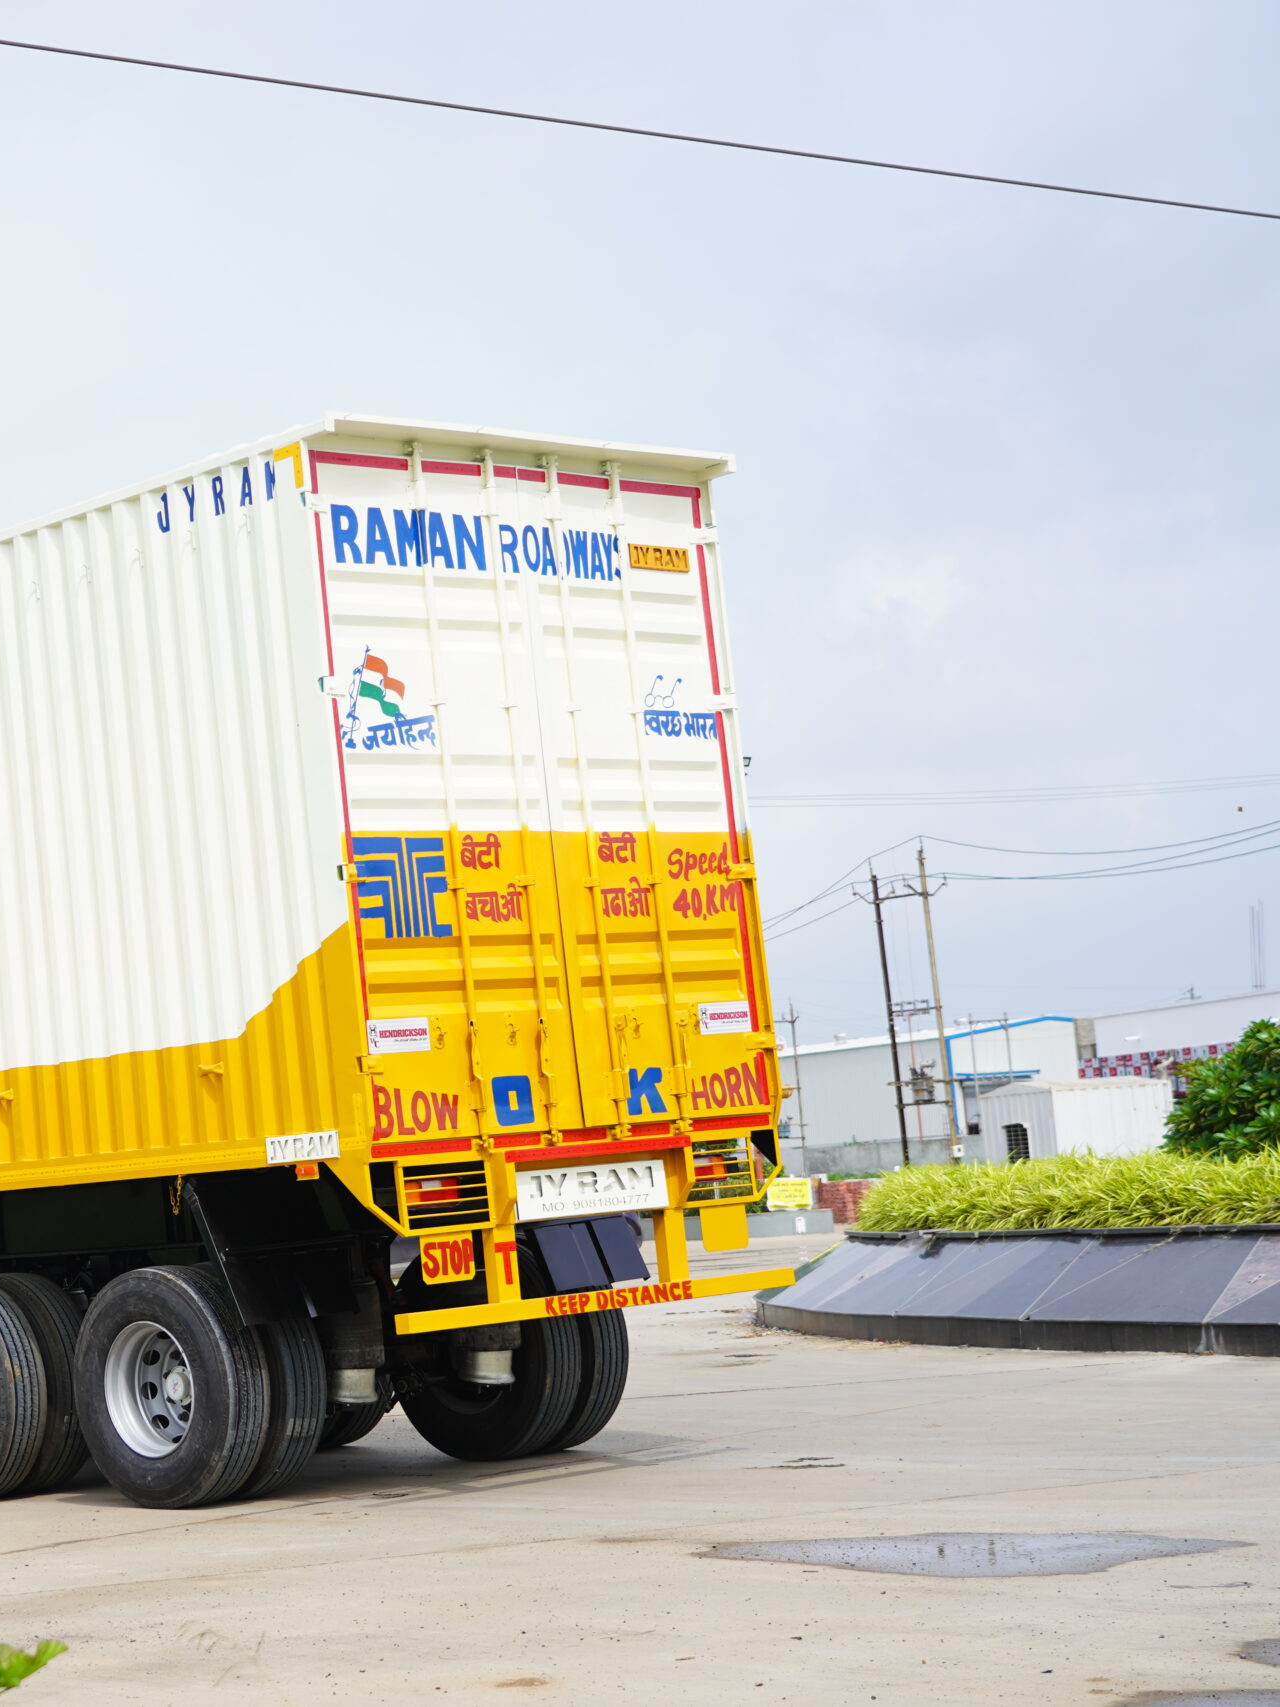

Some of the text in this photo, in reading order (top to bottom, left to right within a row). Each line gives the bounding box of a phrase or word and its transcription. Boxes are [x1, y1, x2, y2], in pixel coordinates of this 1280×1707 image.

[329, 503, 487, 571] RAMAN
[460, 833, 502, 871] बेटी
[597, 831, 637, 864] बेटी
[378, 1028, 428, 1039] HENDRICKSON
[709, 1010, 748, 1021] HENDRICKSON
[373, 1084, 459, 1139] BLOW
[690, 1056, 765, 1111] HORN
[576, 1165, 656, 1194] RAM
[422, 1238, 475, 1279] STOP
[544, 1279, 694, 1316] KEEP DISTANCE
